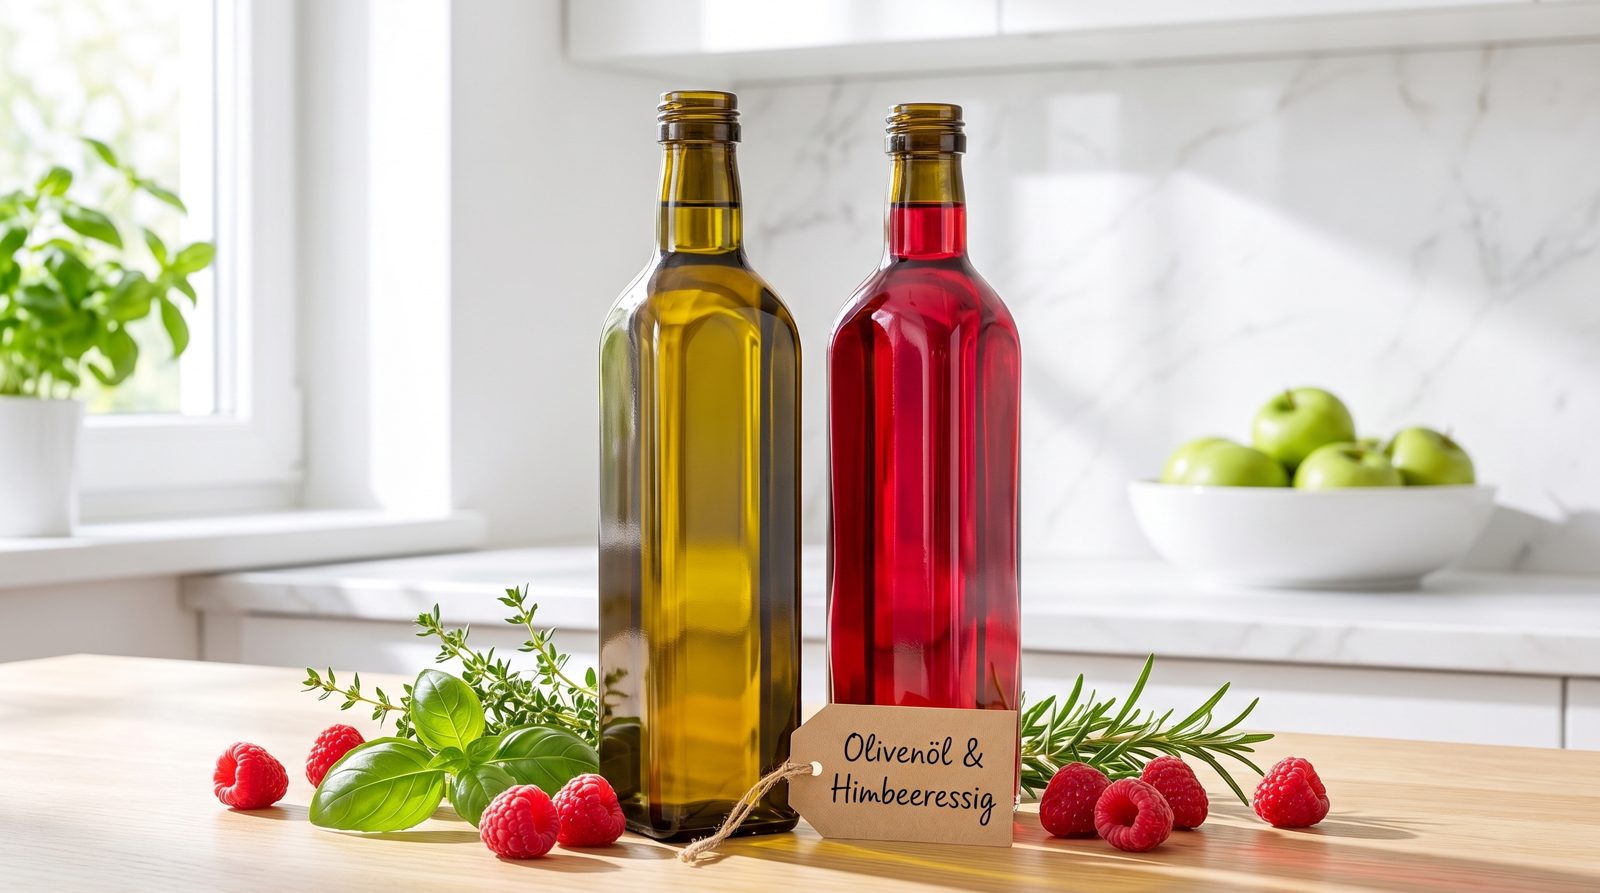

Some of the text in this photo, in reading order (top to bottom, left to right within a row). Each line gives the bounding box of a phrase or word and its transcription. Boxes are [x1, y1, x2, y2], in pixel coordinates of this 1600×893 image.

[844, 732, 984, 769] Olivenöl &
[831, 773, 997, 827] Himbeeressig
